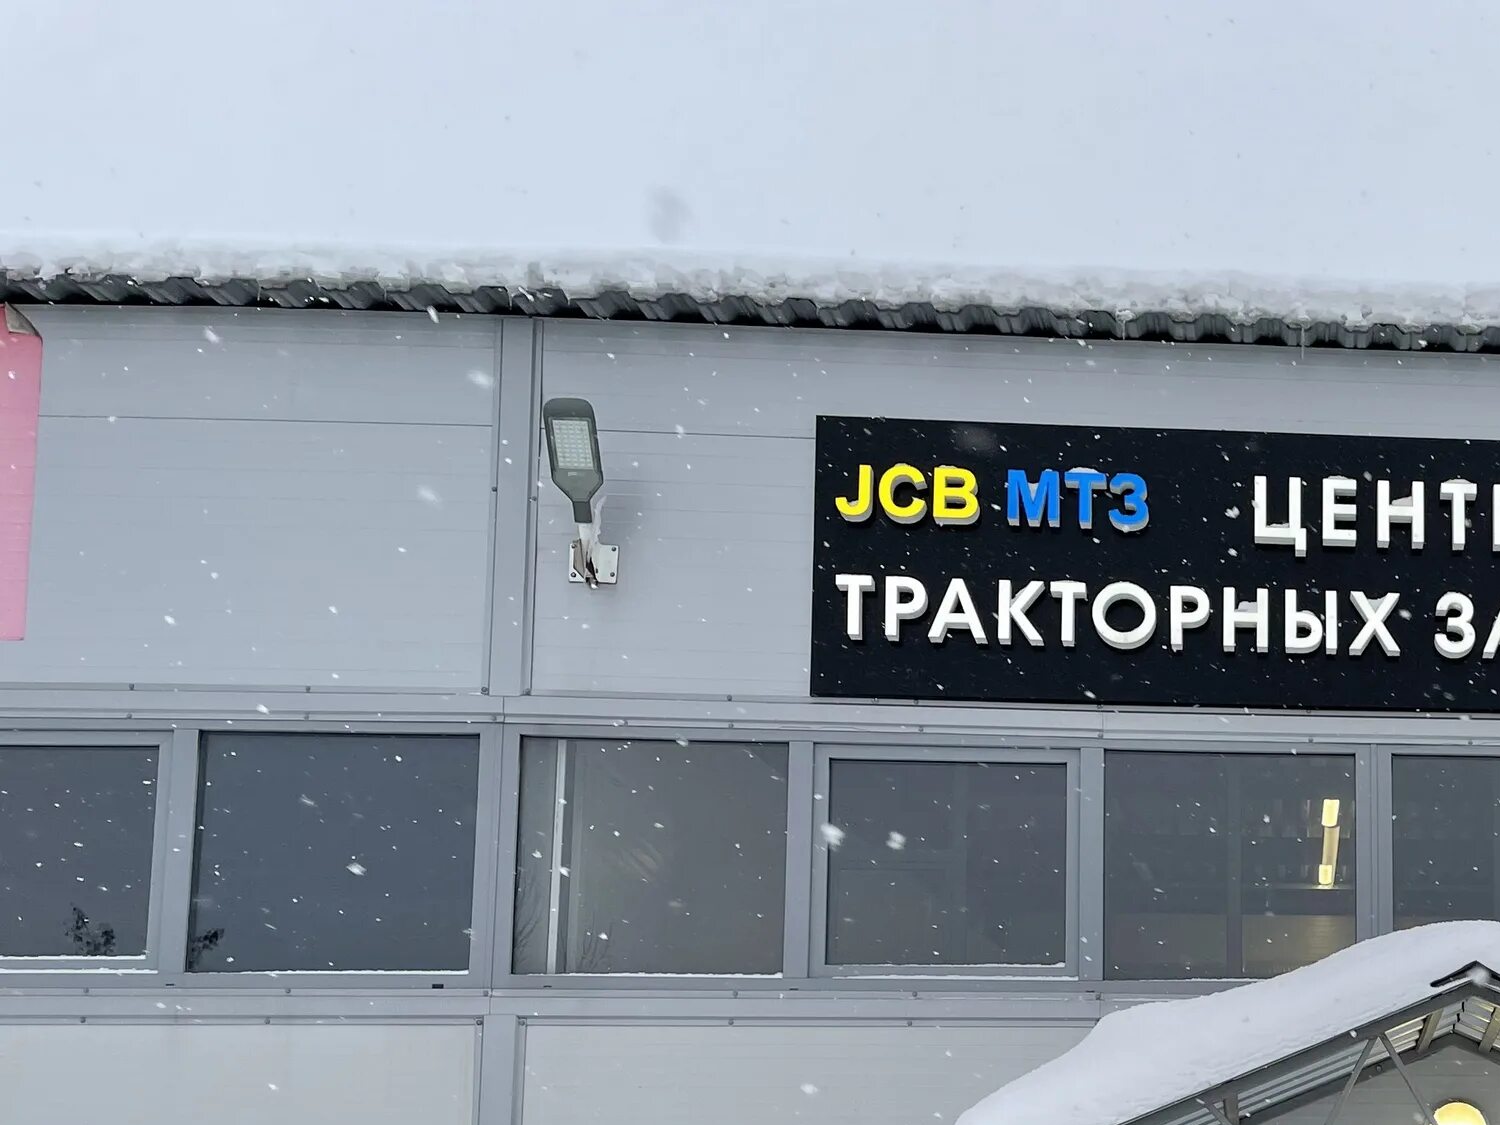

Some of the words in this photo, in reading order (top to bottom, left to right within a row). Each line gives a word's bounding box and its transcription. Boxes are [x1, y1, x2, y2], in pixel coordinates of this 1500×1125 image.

[835, 464, 980, 525] JCB
[1005, 467, 1149, 532] МТЗ
[835, 573, 1400, 656] ТРАКТОРНЫХ
